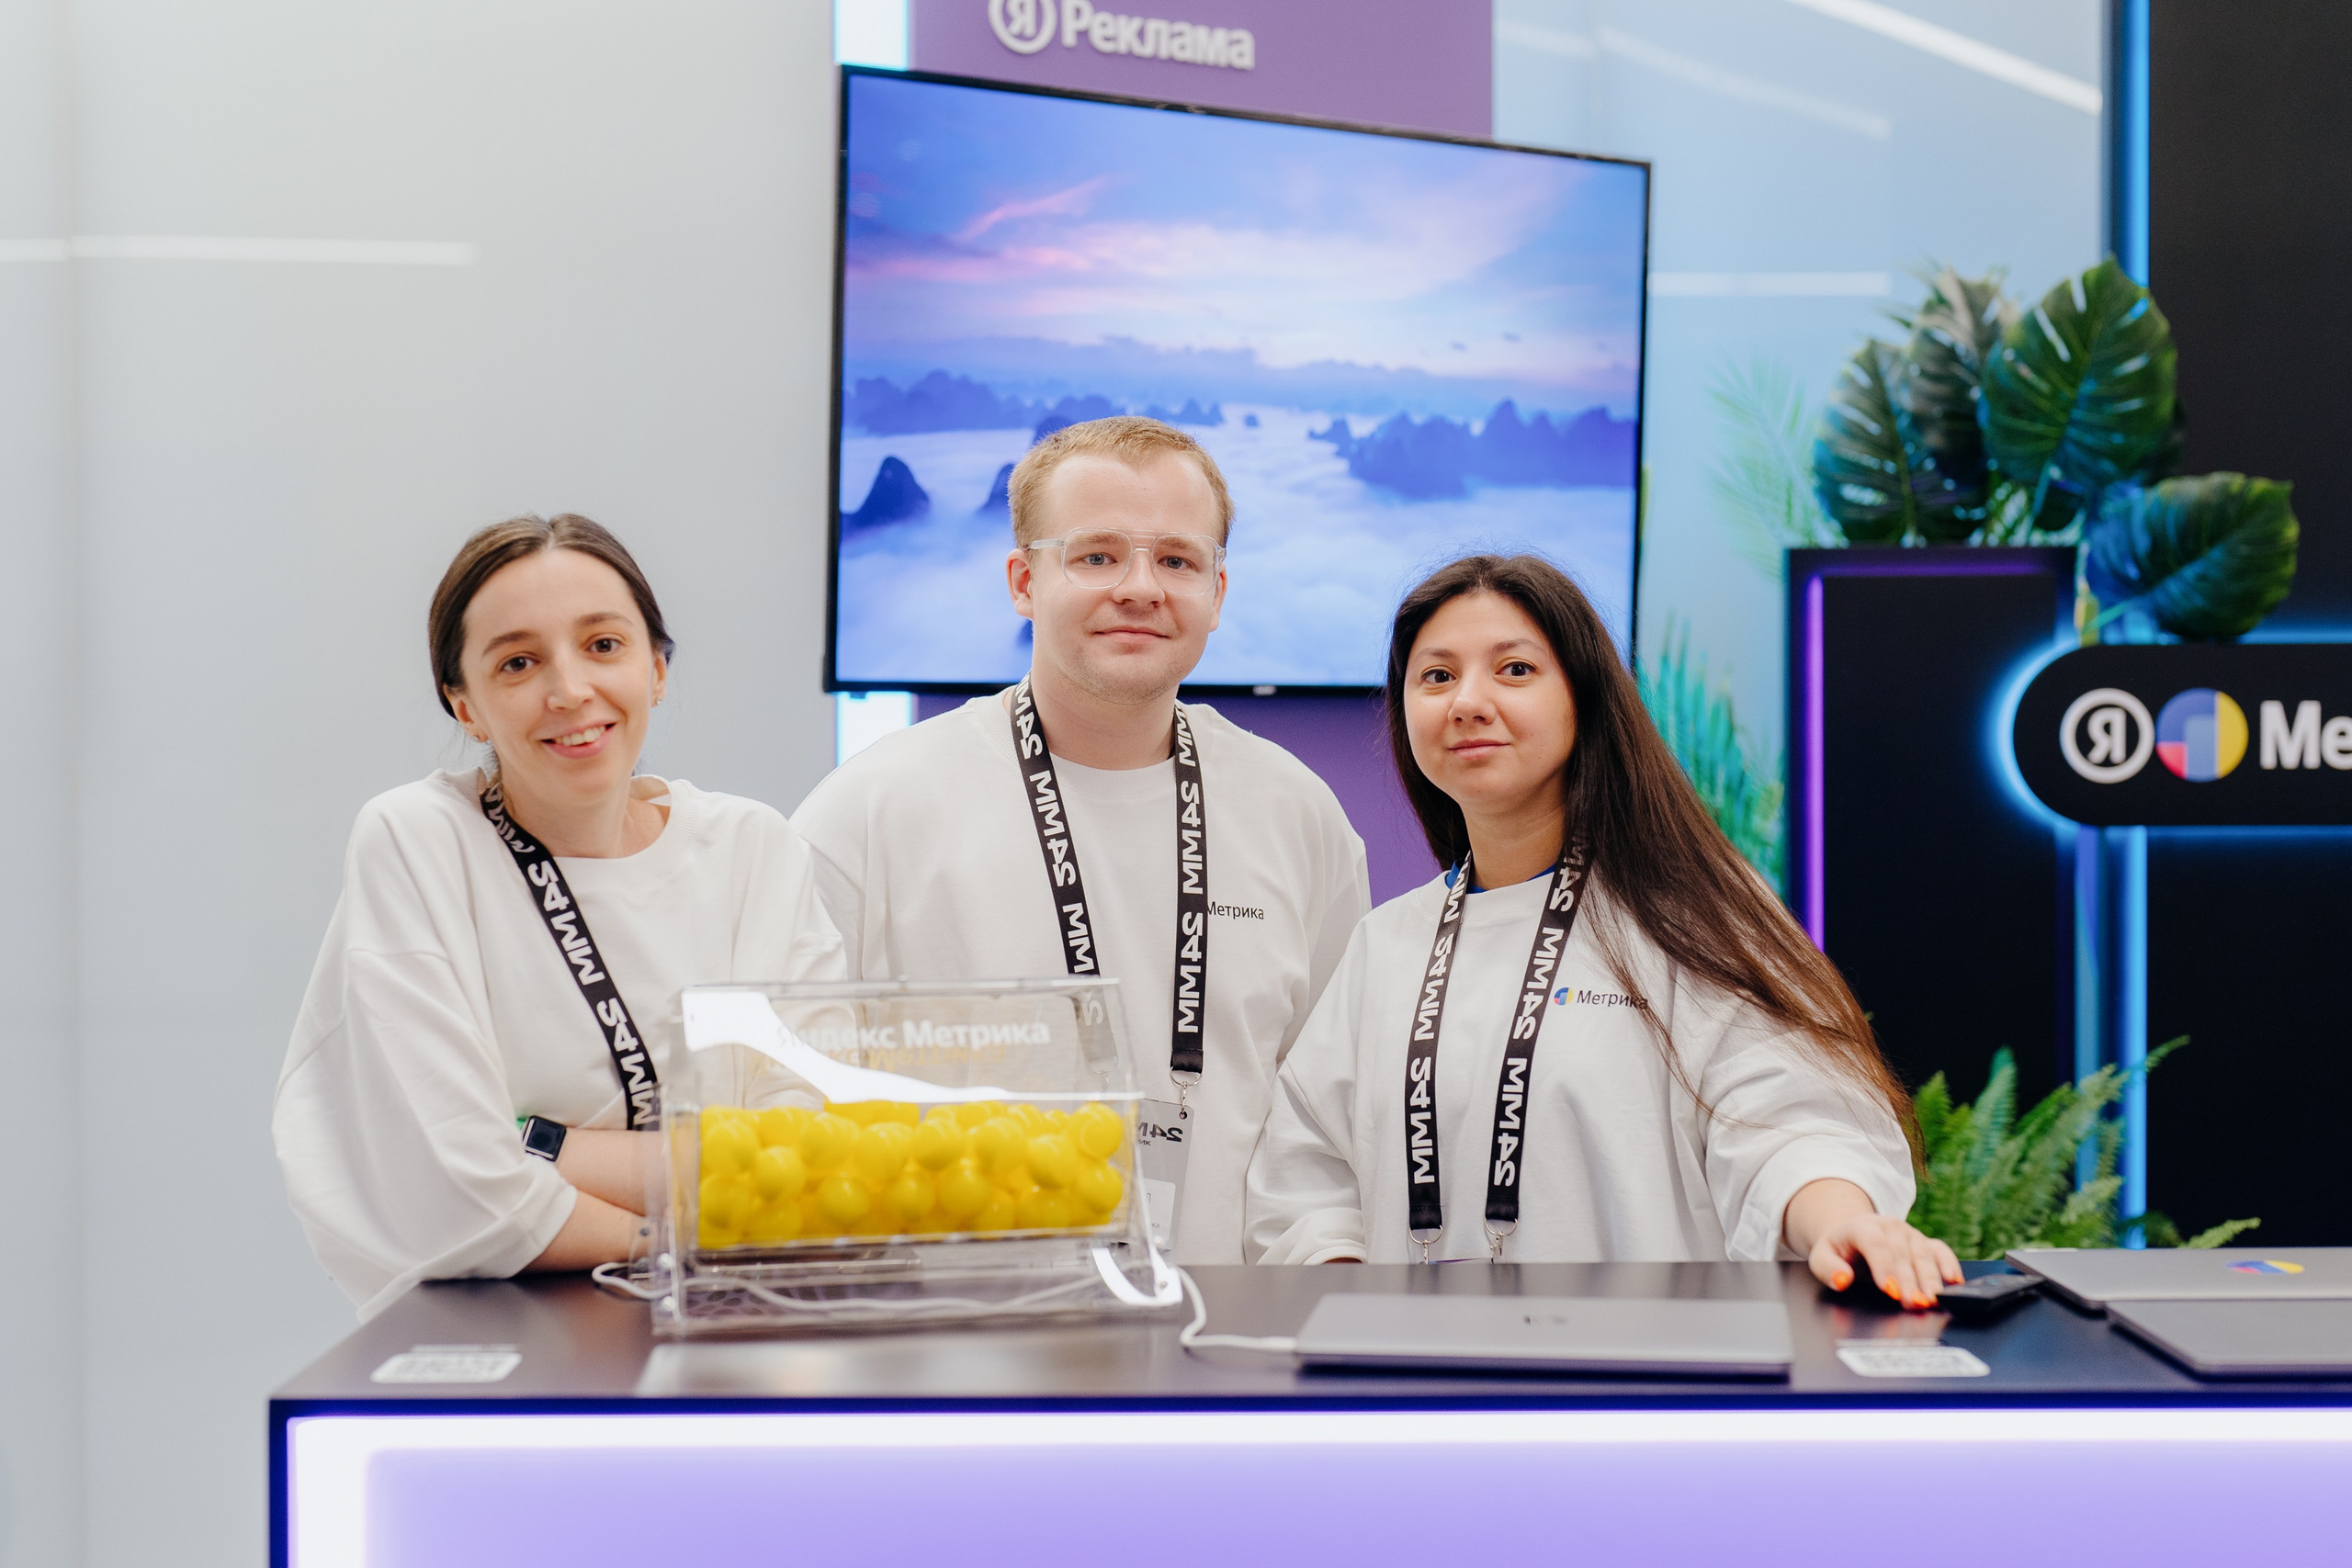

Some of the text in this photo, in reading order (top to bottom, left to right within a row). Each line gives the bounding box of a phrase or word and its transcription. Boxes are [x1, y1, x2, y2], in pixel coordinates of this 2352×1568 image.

[1060, 0, 1255, 70] Реклама
[2259, 699, 2352, 770] Ме
[1207, 900, 1264, 920] Метрика
[1577, 990, 1648, 1010] Метрика
[901, 1019, 1051, 1051] Метрика
